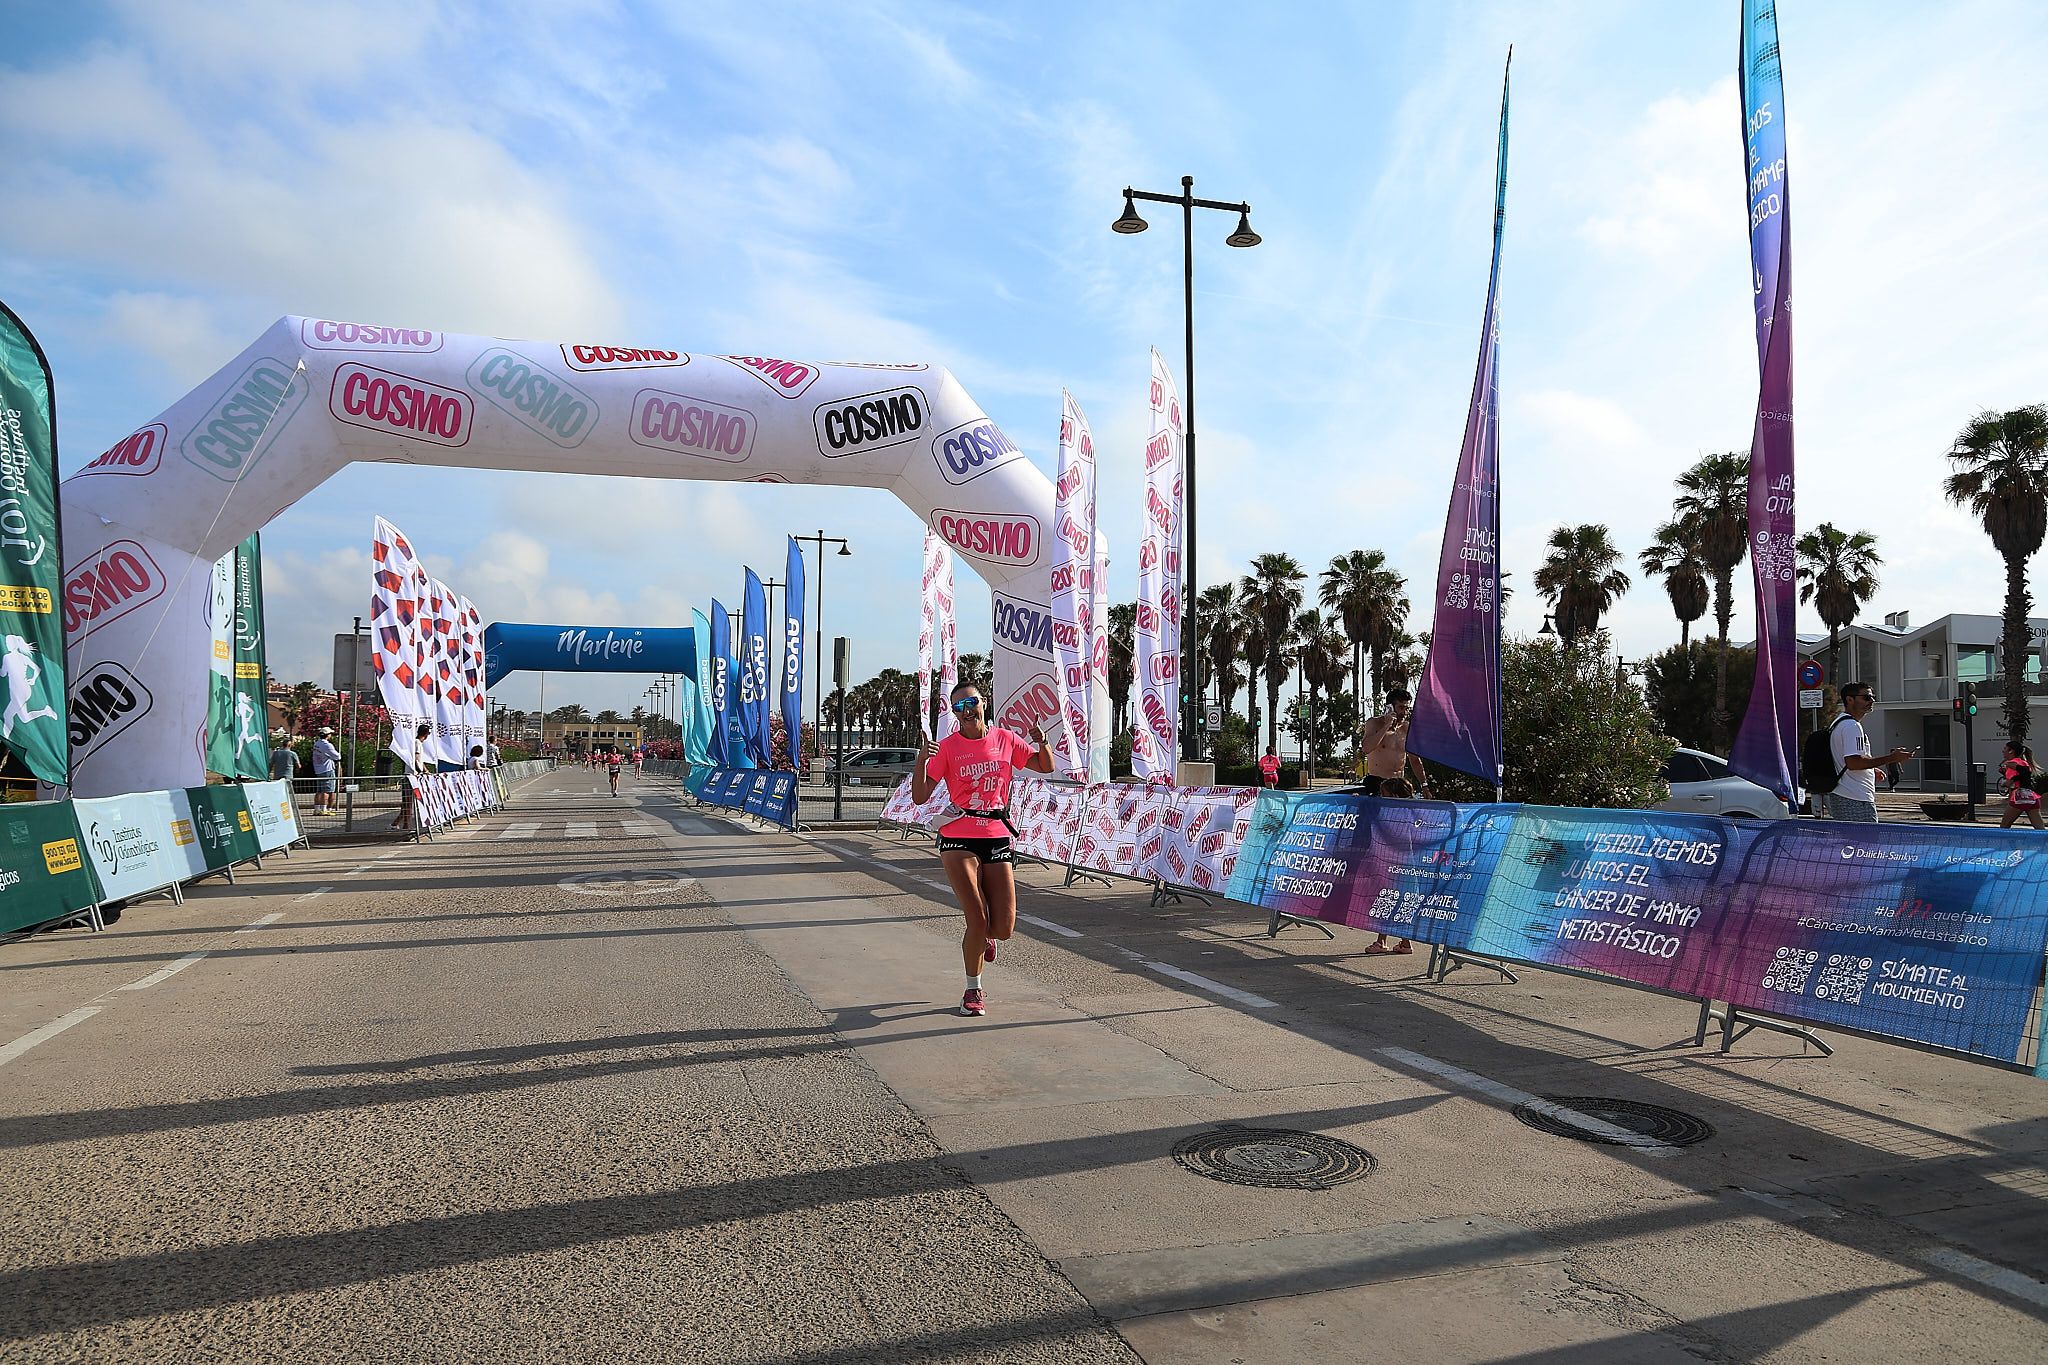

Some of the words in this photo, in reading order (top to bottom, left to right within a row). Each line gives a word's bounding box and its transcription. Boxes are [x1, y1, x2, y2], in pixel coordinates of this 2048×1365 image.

[343, 372, 462, 440] COSMO
[479, 354, 588, 438] COSMO
[194, 367, 296, 469] COSMO
[641, 397, 747, 455] COSMO
[824, 393, 922, 450] COSMO
[940, 515, 1031, 558] COSMO
[65, 551, 151, 632] OSMO
[993, 598, 1054, 654] COSM
[960, 761, 1000, 778] CARRERA
[1187, 806, 1210, 842] COSMO
[1312, 834, 1326, 850] EL
[1202, 832, 1224, 854] COSMO
[1270, 848, 1310, 872] CÁNCER
[1308, 856, 1322, 872] DE
[1584, 832, 1722, 866] VISIBILICEMOS
[1272, 874, 1334, 898] METASTÁSICO
[1562, 859, 1624, 882] JUNTOS
[1626, 864, 1650, 888] EL
[1554, 884, 1617, 912] CÁNCER
[1616, 893, 1646, 917] DE
[1645, 899, 1702, 928] MAMA
[1557, 918, 1681, 959] METASTÁSICO
[1797, 916, 1988, 946] #CáncerDeMamaMetastásico
[1880, 958, 1952, 988] SÚMATE
[1950, 974, 1969, 992] AL
[1872, 982, 1965, 1010] MOVIMIENTO
